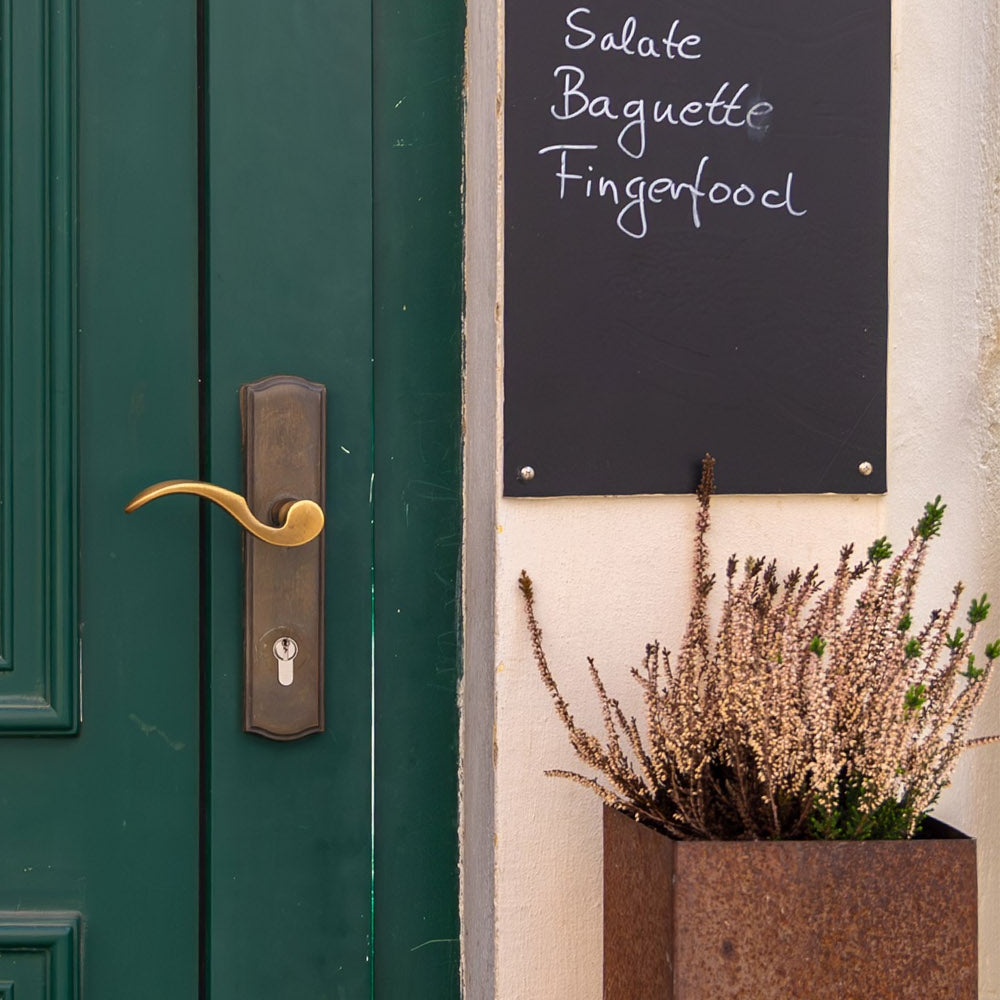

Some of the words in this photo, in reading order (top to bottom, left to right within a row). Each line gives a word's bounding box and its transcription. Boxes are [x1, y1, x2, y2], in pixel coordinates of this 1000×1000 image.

[564, 7, 702, 60] Salate
[550, 65, 774, 159] Baguette
[537, 144, 808, 239] Fingerfood
